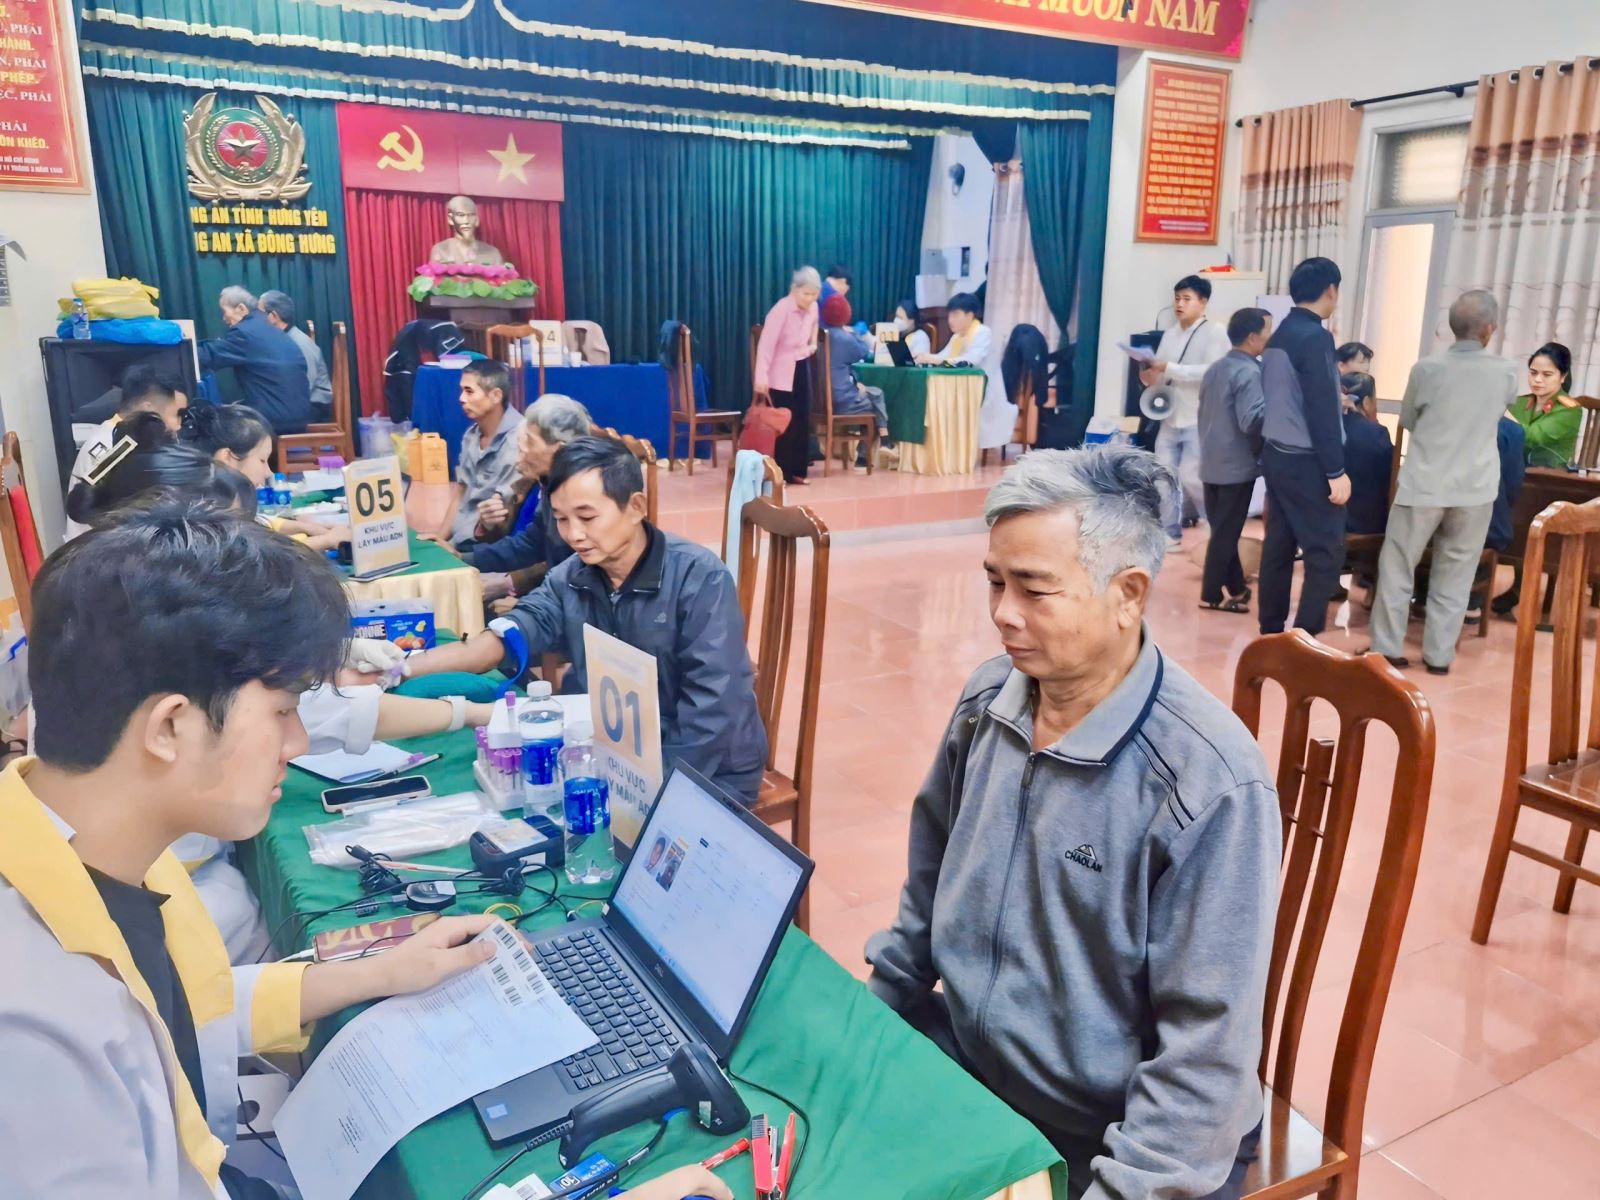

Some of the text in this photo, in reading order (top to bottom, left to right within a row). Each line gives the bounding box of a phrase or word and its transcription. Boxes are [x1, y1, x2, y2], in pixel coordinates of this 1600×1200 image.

[20, 90, 52, 103] PHẢI
[0, 119, 28, 132] HẢI
[211, 207, 230, 225] AN
[232, 202, 264, 225] TỈNH
[268, 207, 302, 226] HƯNG
[303, 206, 328, 227] YÊN
[212, 231, 232, 252] AN
[235, 228, 256, 253] XÃ
[257, 229, 296, 254] ĐÔNG
[298, 231, 336, 254] HƯNG
[355, 478, 395, 517] 05
[364, 525, 379, 534] KHU
[600, 675, 642, 758] 01
